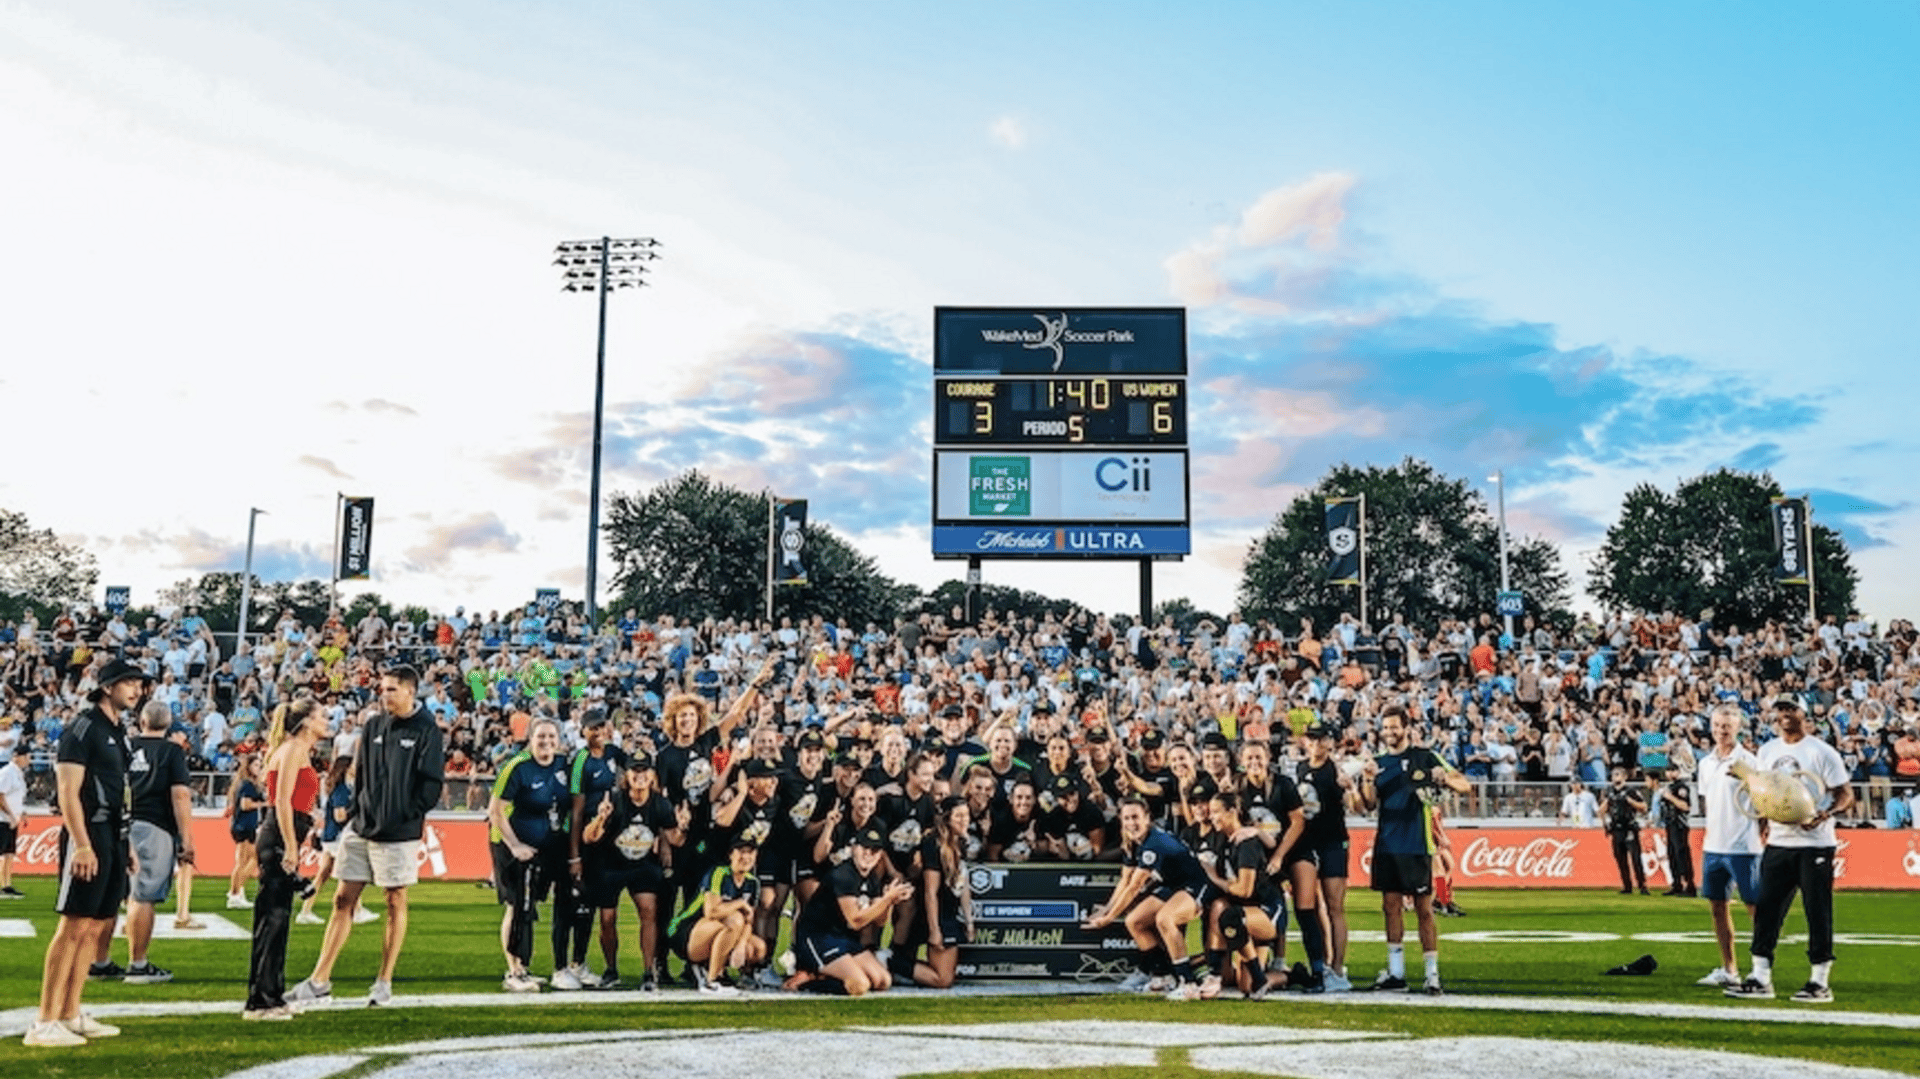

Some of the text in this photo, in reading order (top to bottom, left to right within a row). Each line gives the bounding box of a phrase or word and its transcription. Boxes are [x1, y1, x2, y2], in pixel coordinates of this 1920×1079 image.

[981, 329, 1135, 342] WakeMed Soccer Park
[946, 382, 995, 397] COURAGE
[1048, 378, 1109, 410] 1:40
[1122, 382, 1178, 397] US WOMEN
[975, 401, 992, 434] 3
[1022, 415, 1084, 441] PERIOD 5
[1153, 402, 1172, 434] 6
[971, 476, 1029, 491] FRESH
[1095, 456, 1150, 492] Cii
[349, 505, 363, 556] MILLION
[976, 531, 1145, 549] Michelob ULTRA
[1781, 507, 1798, 572] SEVENS
[1460, 837, 1579, 877] Coca-Cola
